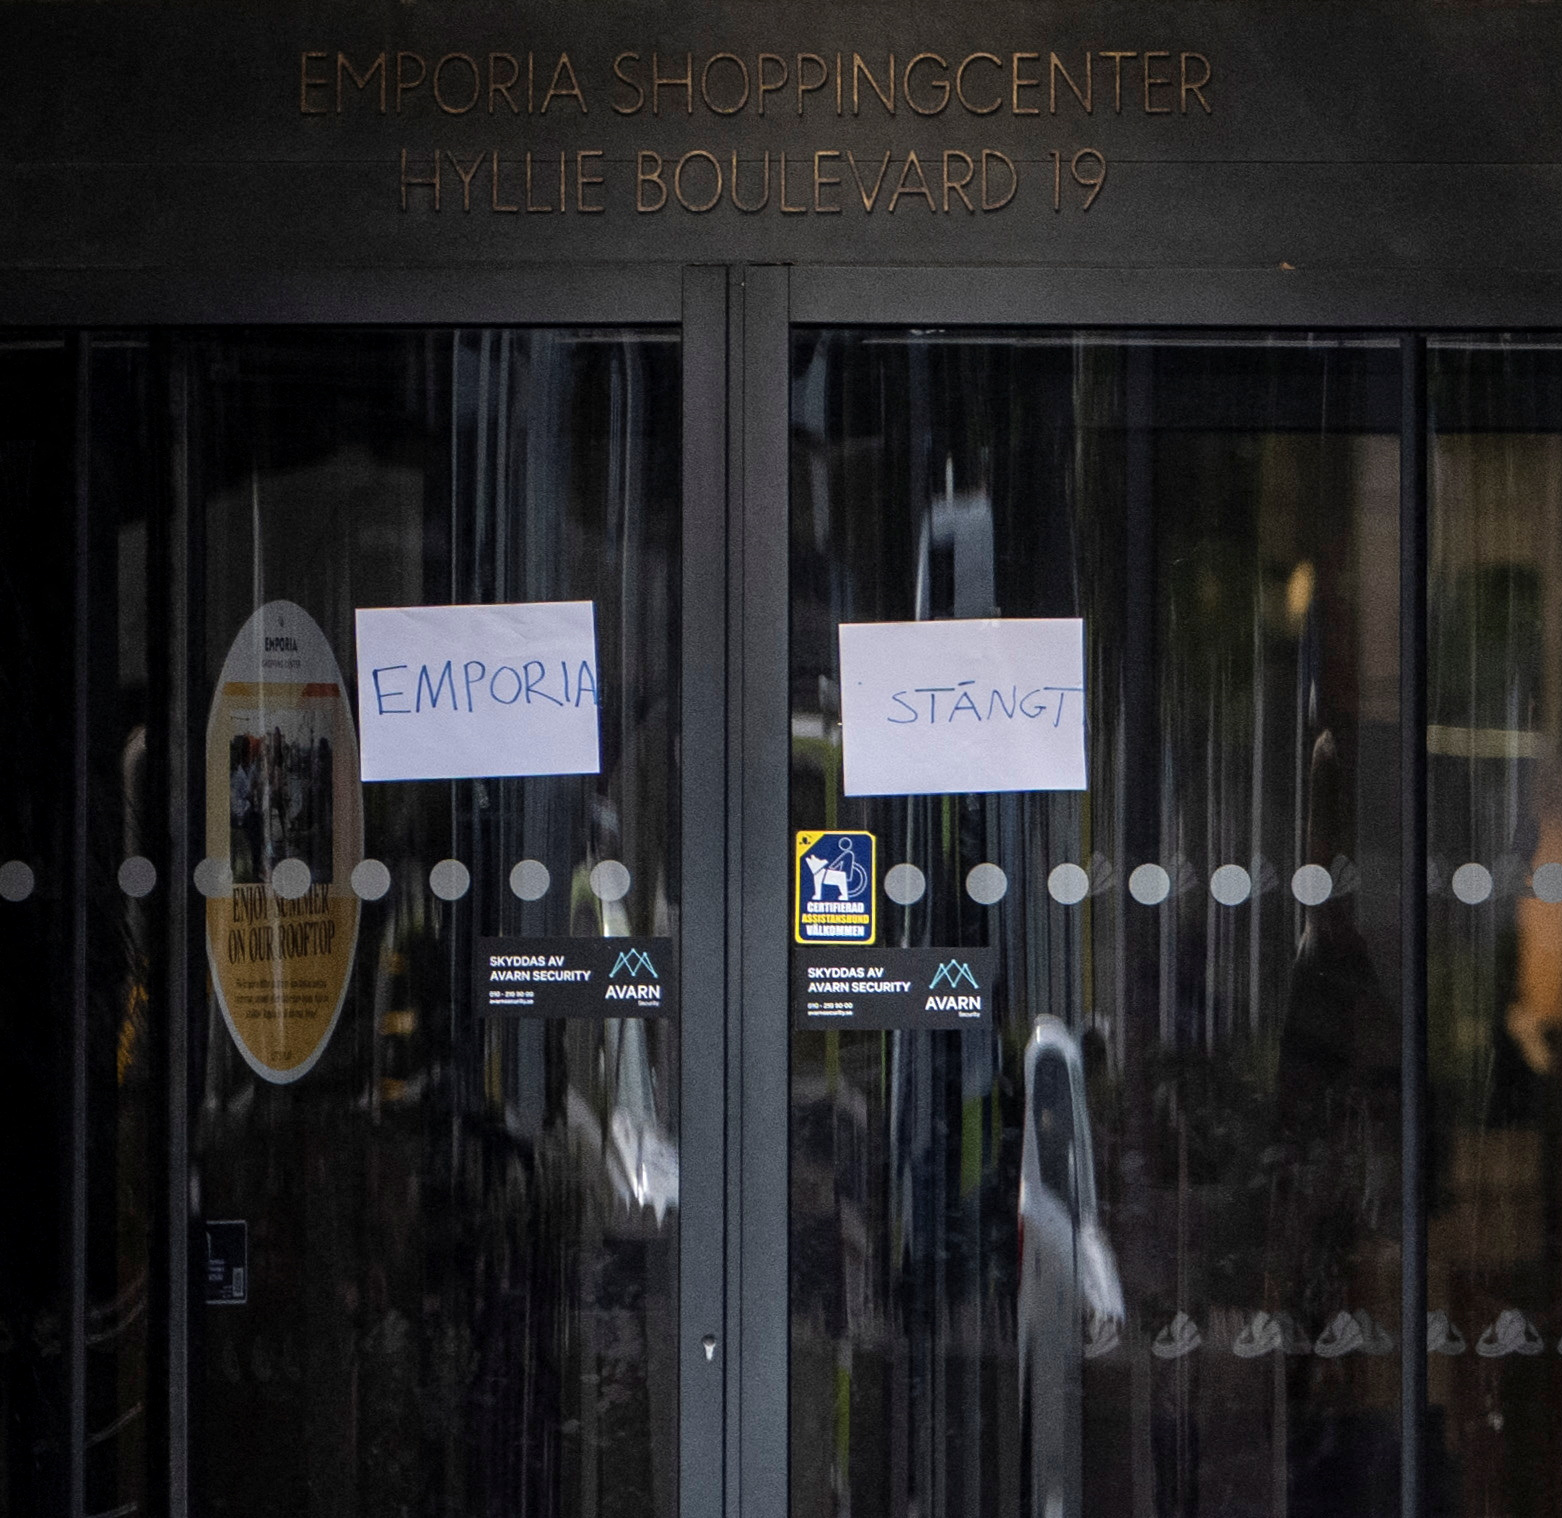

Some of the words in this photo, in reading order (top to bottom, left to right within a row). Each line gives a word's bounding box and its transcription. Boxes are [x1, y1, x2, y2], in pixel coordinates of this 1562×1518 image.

[298, 50, 588, 117] EMPORIA
[610, 50, 1213, 117] SHOPPINGCENTER
[398, 148, 606, 214] HYLLIE
[635, 148, 1019, 214] BOULEVARD
[1046, 147, 1109, 213] 19
[264, 637, 298, 651] EMPORIA
[372, 660, 599, 715] EMPORIA
[806, 902, 865, 914] CERTIFIERAD
[805, 924, 865, 937] VÄLKOMMEN
[228, 929, 246, 965] ON
[249, 925, 274, 962] OUR
[278, 919, 335, 960] ROOFTOP
[489, 955, 546, 967] SKYDDAS
[547, 955, 565, 967] AV
[489, 970, 531, 981] AVARN
[532, 970, 592, 982] SECURITY
[807, 967, 865, 979] SKYDDAS
[866, 967, 884, 978] AV
[604, 985, 661, 999] AVARN
[808, 982, 850, 993] AVARN
[851, 982, 911, 993] SECURITY
[925, 996, 981, 1010] AVARN
